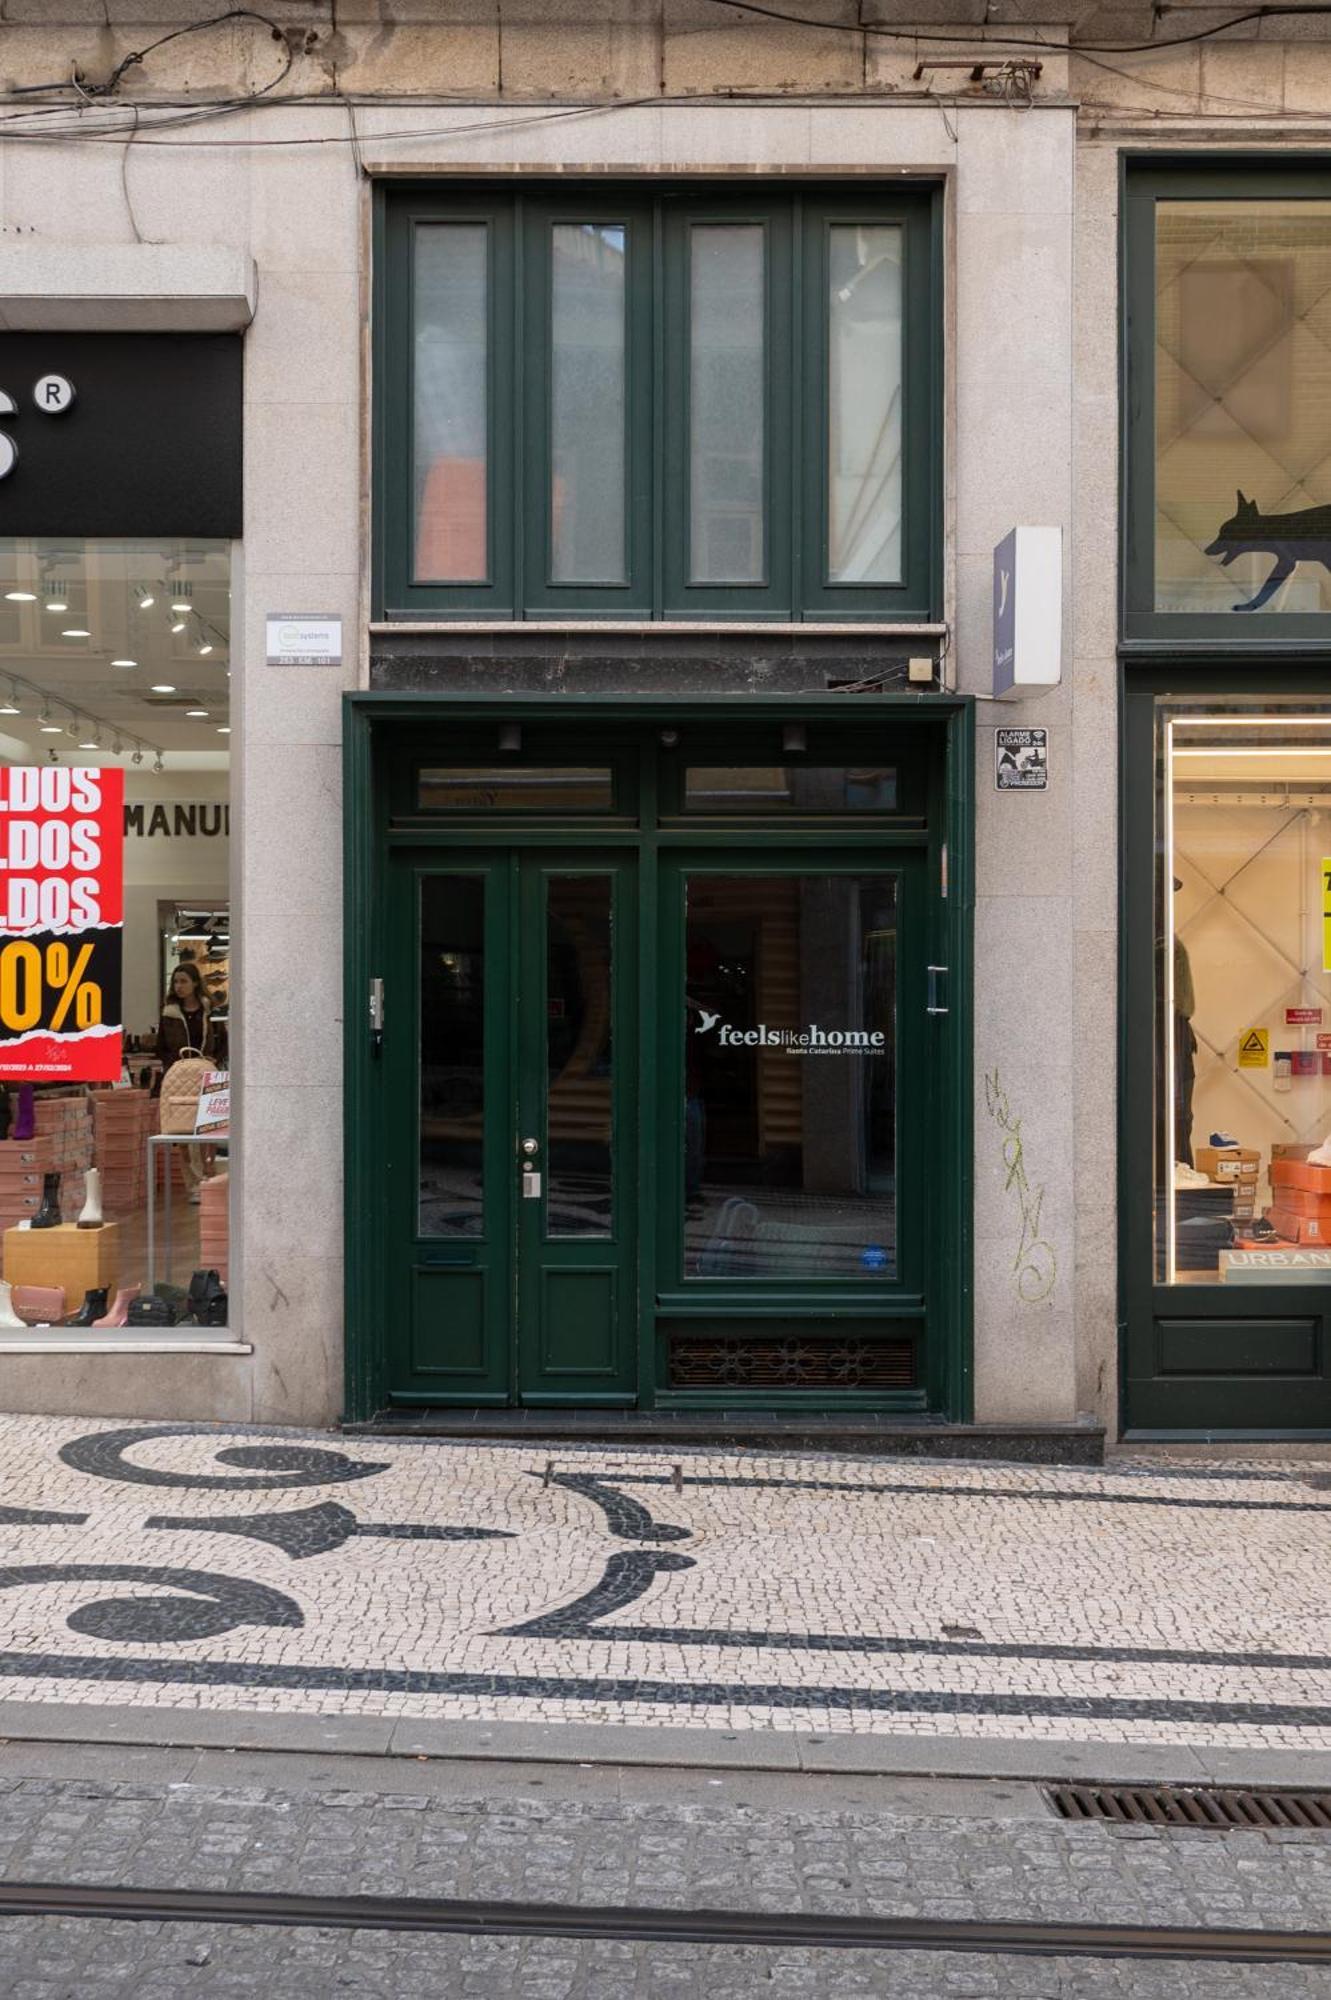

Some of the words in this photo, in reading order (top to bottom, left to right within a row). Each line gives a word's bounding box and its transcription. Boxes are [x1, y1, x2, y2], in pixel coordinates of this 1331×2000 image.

[999, 736, 1032, 744] LIGADO
[718, 1024, 885, 1046] feelslikehome
[842, 1047, 863, 1055] Prime
[863, 1047, 885, 1055] Suites
[1228, 1252, 1331, 1266] URBAN
